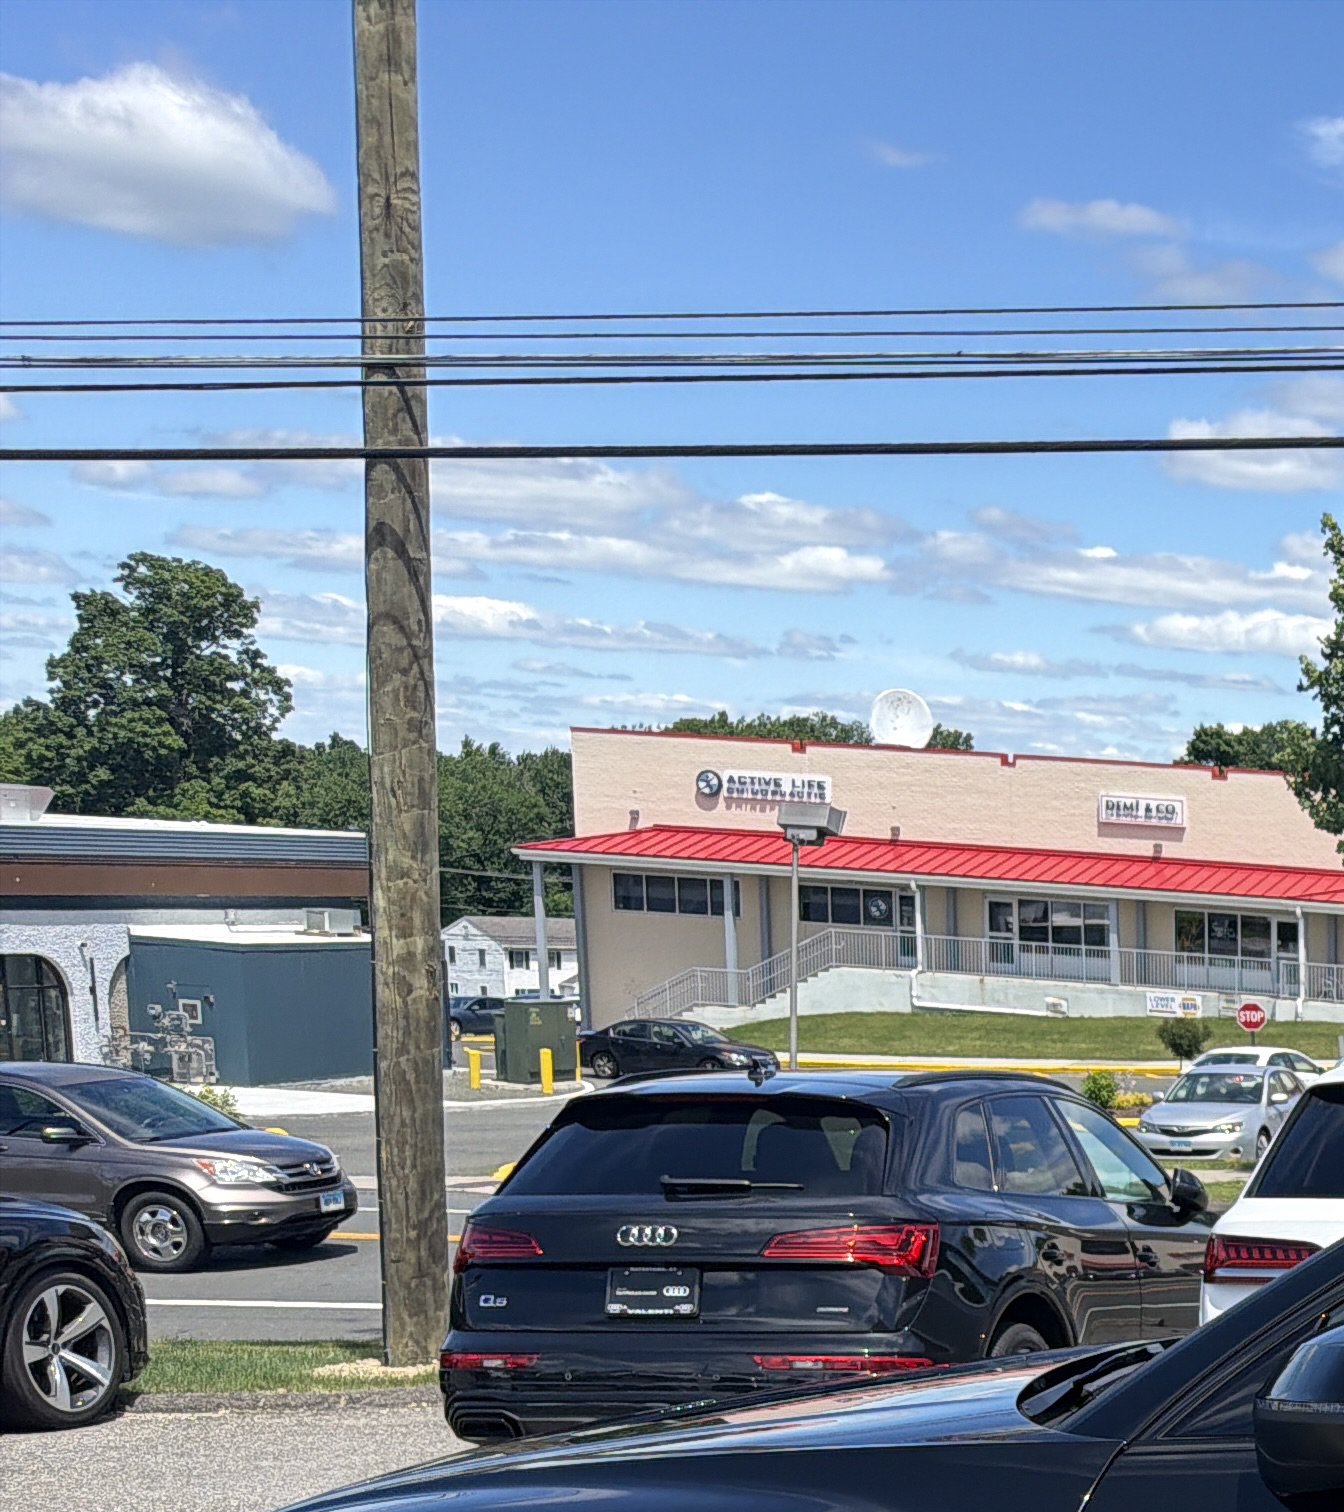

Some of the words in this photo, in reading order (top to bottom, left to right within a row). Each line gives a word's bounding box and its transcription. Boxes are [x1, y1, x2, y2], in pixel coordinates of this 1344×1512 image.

[726, 775, 783, 789] ACTIVE
[792, 778, 826, 791] LIFE
[1239, 1010, 1264, 1023] STOP
